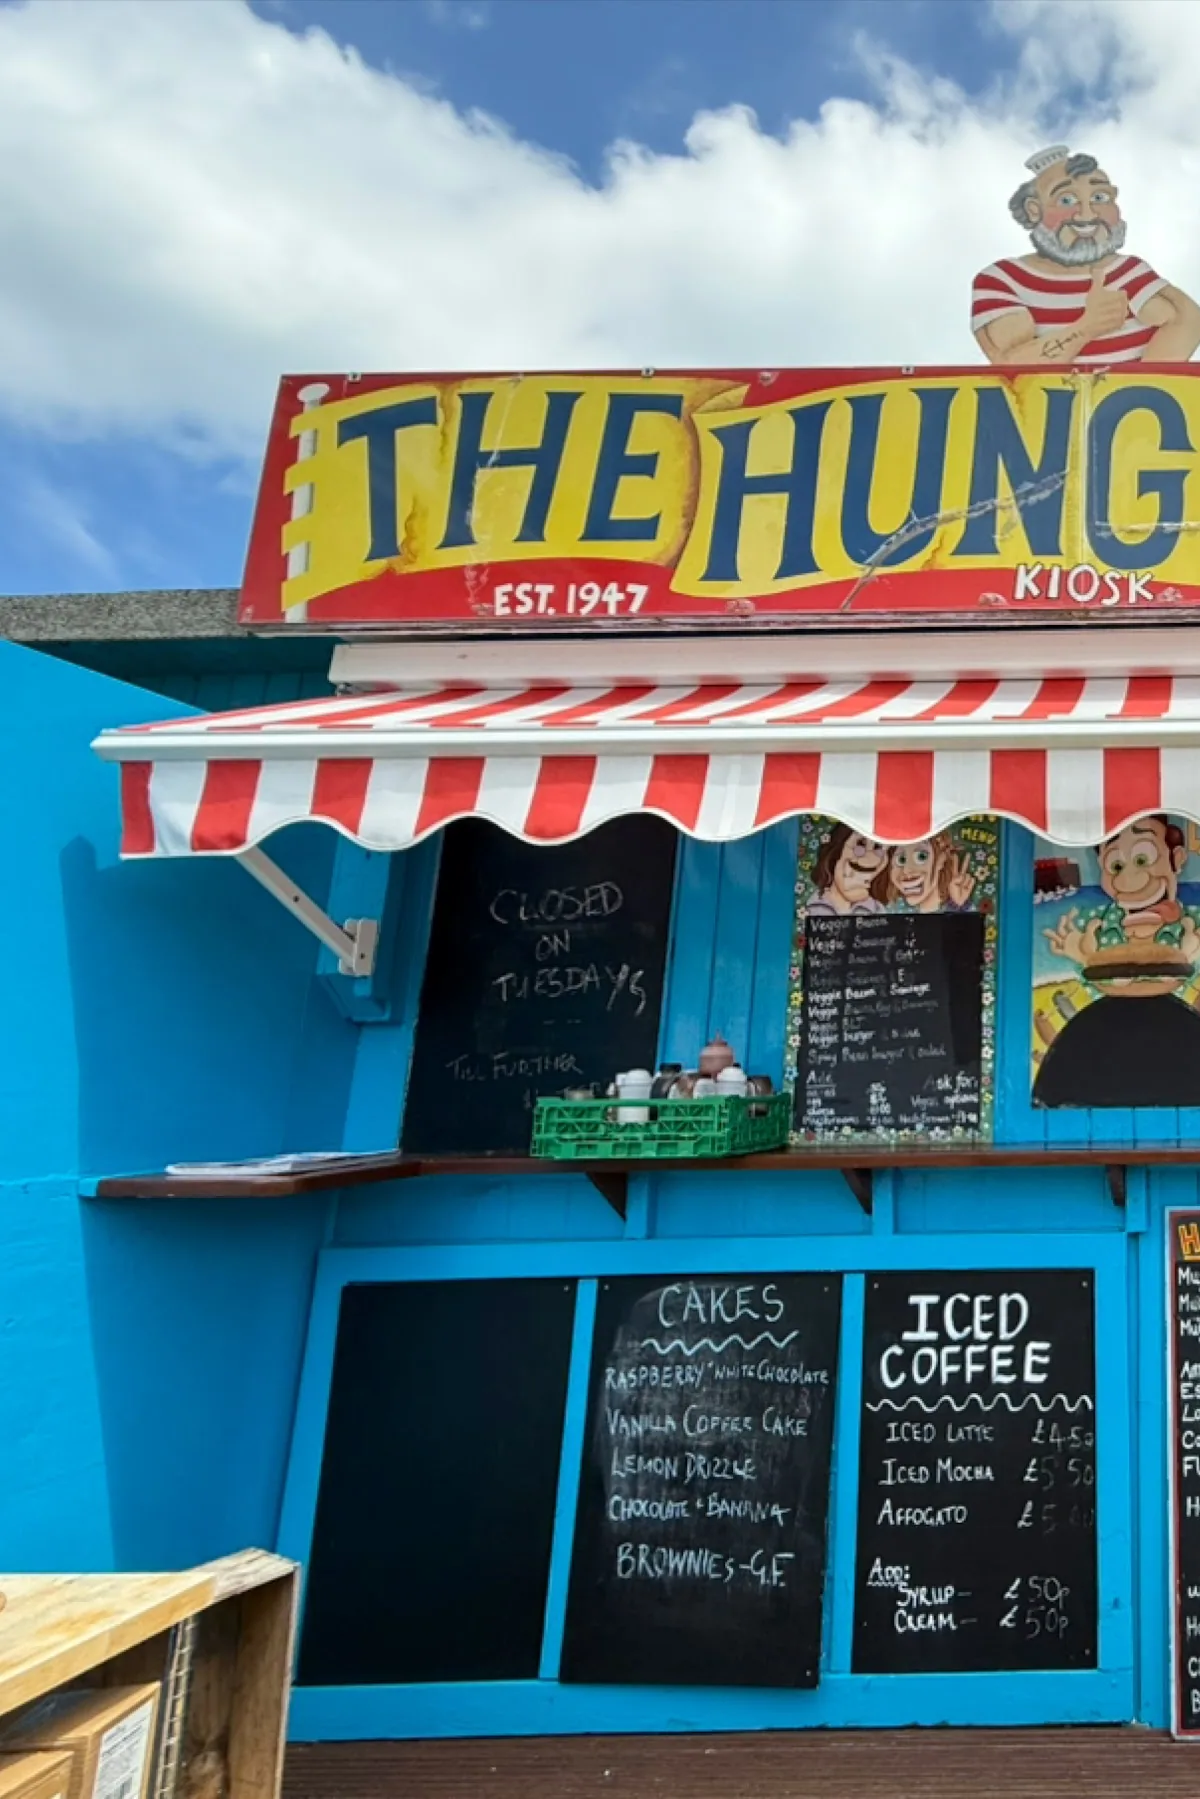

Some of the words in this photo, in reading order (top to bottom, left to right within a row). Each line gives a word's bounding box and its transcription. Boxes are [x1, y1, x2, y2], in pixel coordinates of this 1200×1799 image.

[337, 390, 684, 562] THE
[494, 584, 555, 616] EST.
[567, 583, 649, 615] 1947
[1014, 563, 1154, 605] KIOSK
[489, 881, 624, 924] CLOSED
[535, 929, 570, 960] ON
[492, 963, 646, 1016] TUESDAYS
[658, 1280, 785, 1328] CAKES
[902, 1292, 1029, 1341] ICED
[605, 1361, 704, 1390] RASPBERRY
[880, 1341, 1052, 1389] COFFEE
[605, 1406, 677, 1437] VANILLA
[683, 1404, 753, 1436] COFFEE
[762, 1406, 808, 1436] CAKE
[885, 1422, 936, 1444] ICED
[947, 1423, 994, 1442] LATTE
[611, 1447, 678, 1478] LEMON
[685, 1452, 757, 1484] DRIZZLE
[878, 1458, 929, 1486] ICED
[936, 1456, 995, 1484] MOCHA
[607, 1495, 690, 1521] CHOCOLATE
[877, 1498, 968, 1526] AFFOGATO
